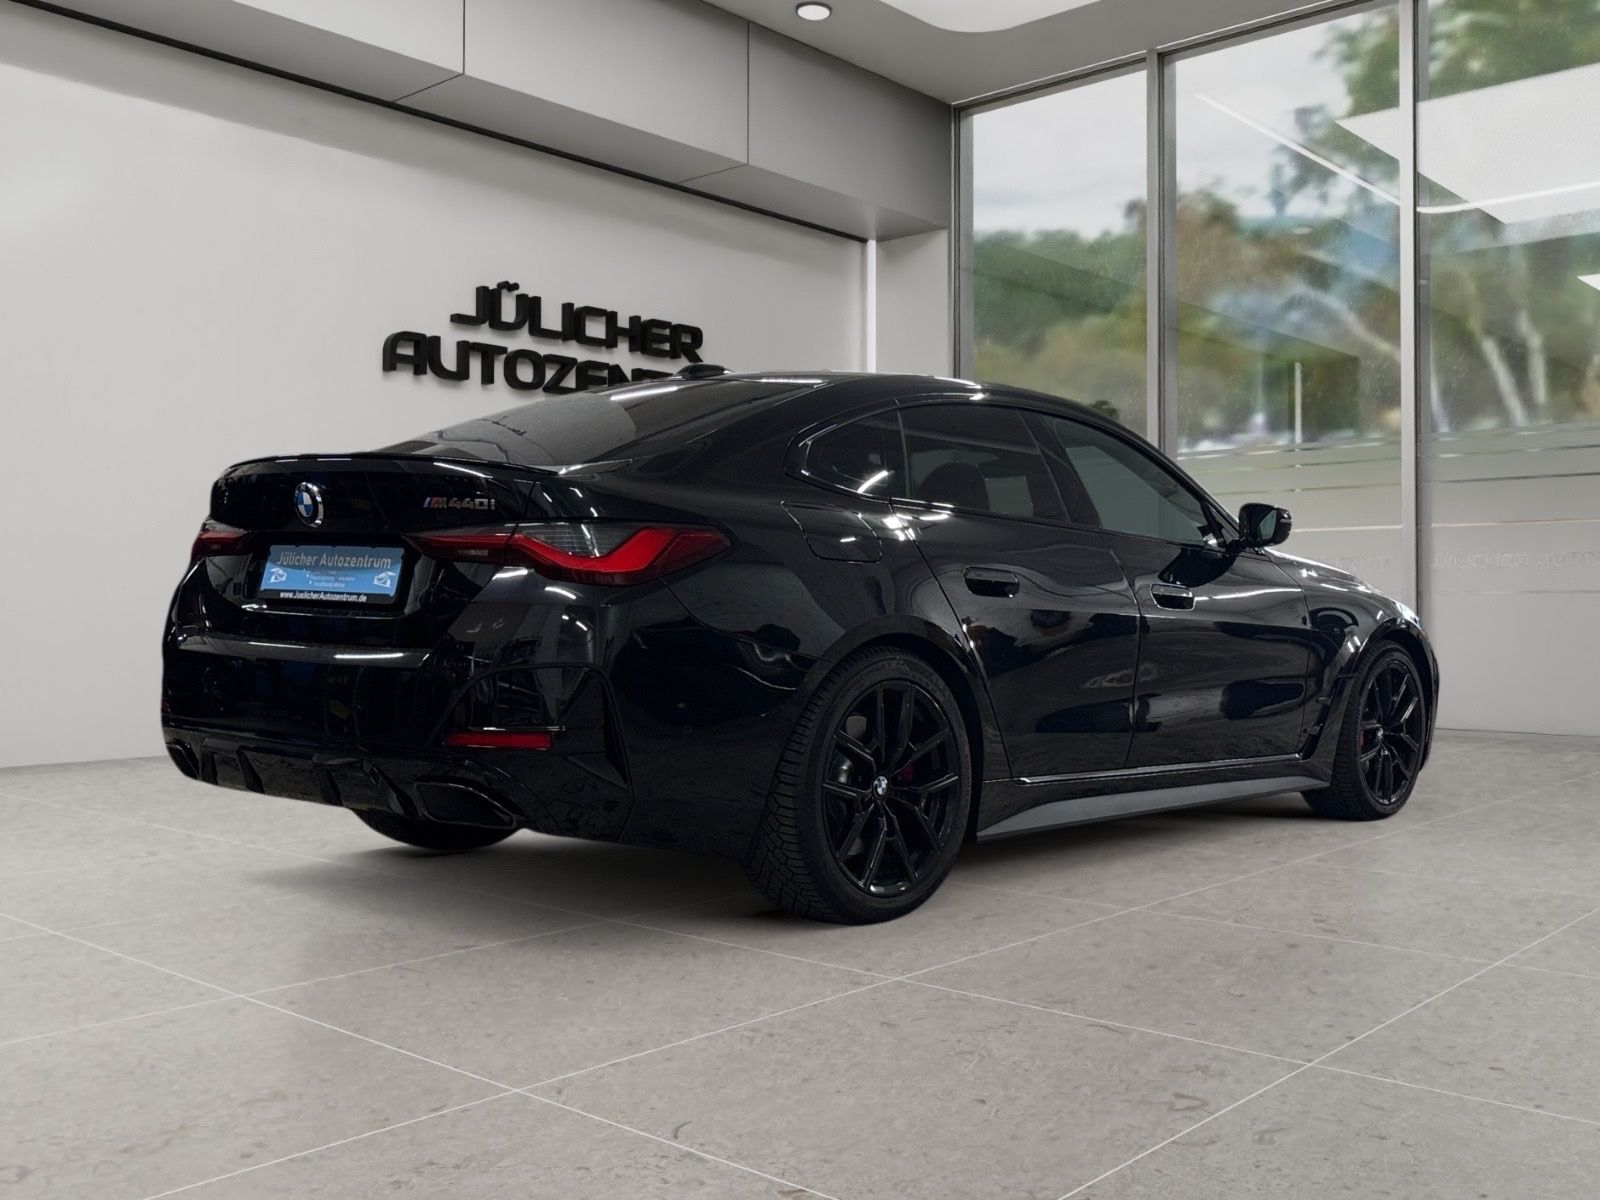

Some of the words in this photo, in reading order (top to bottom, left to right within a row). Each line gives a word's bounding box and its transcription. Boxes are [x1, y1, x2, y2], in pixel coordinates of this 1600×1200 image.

[450, 280, 704, 363] JÜLICHER
[276, 551, 318, 567] Jülicher
[319, 553, 392, 569] Autozentrum
